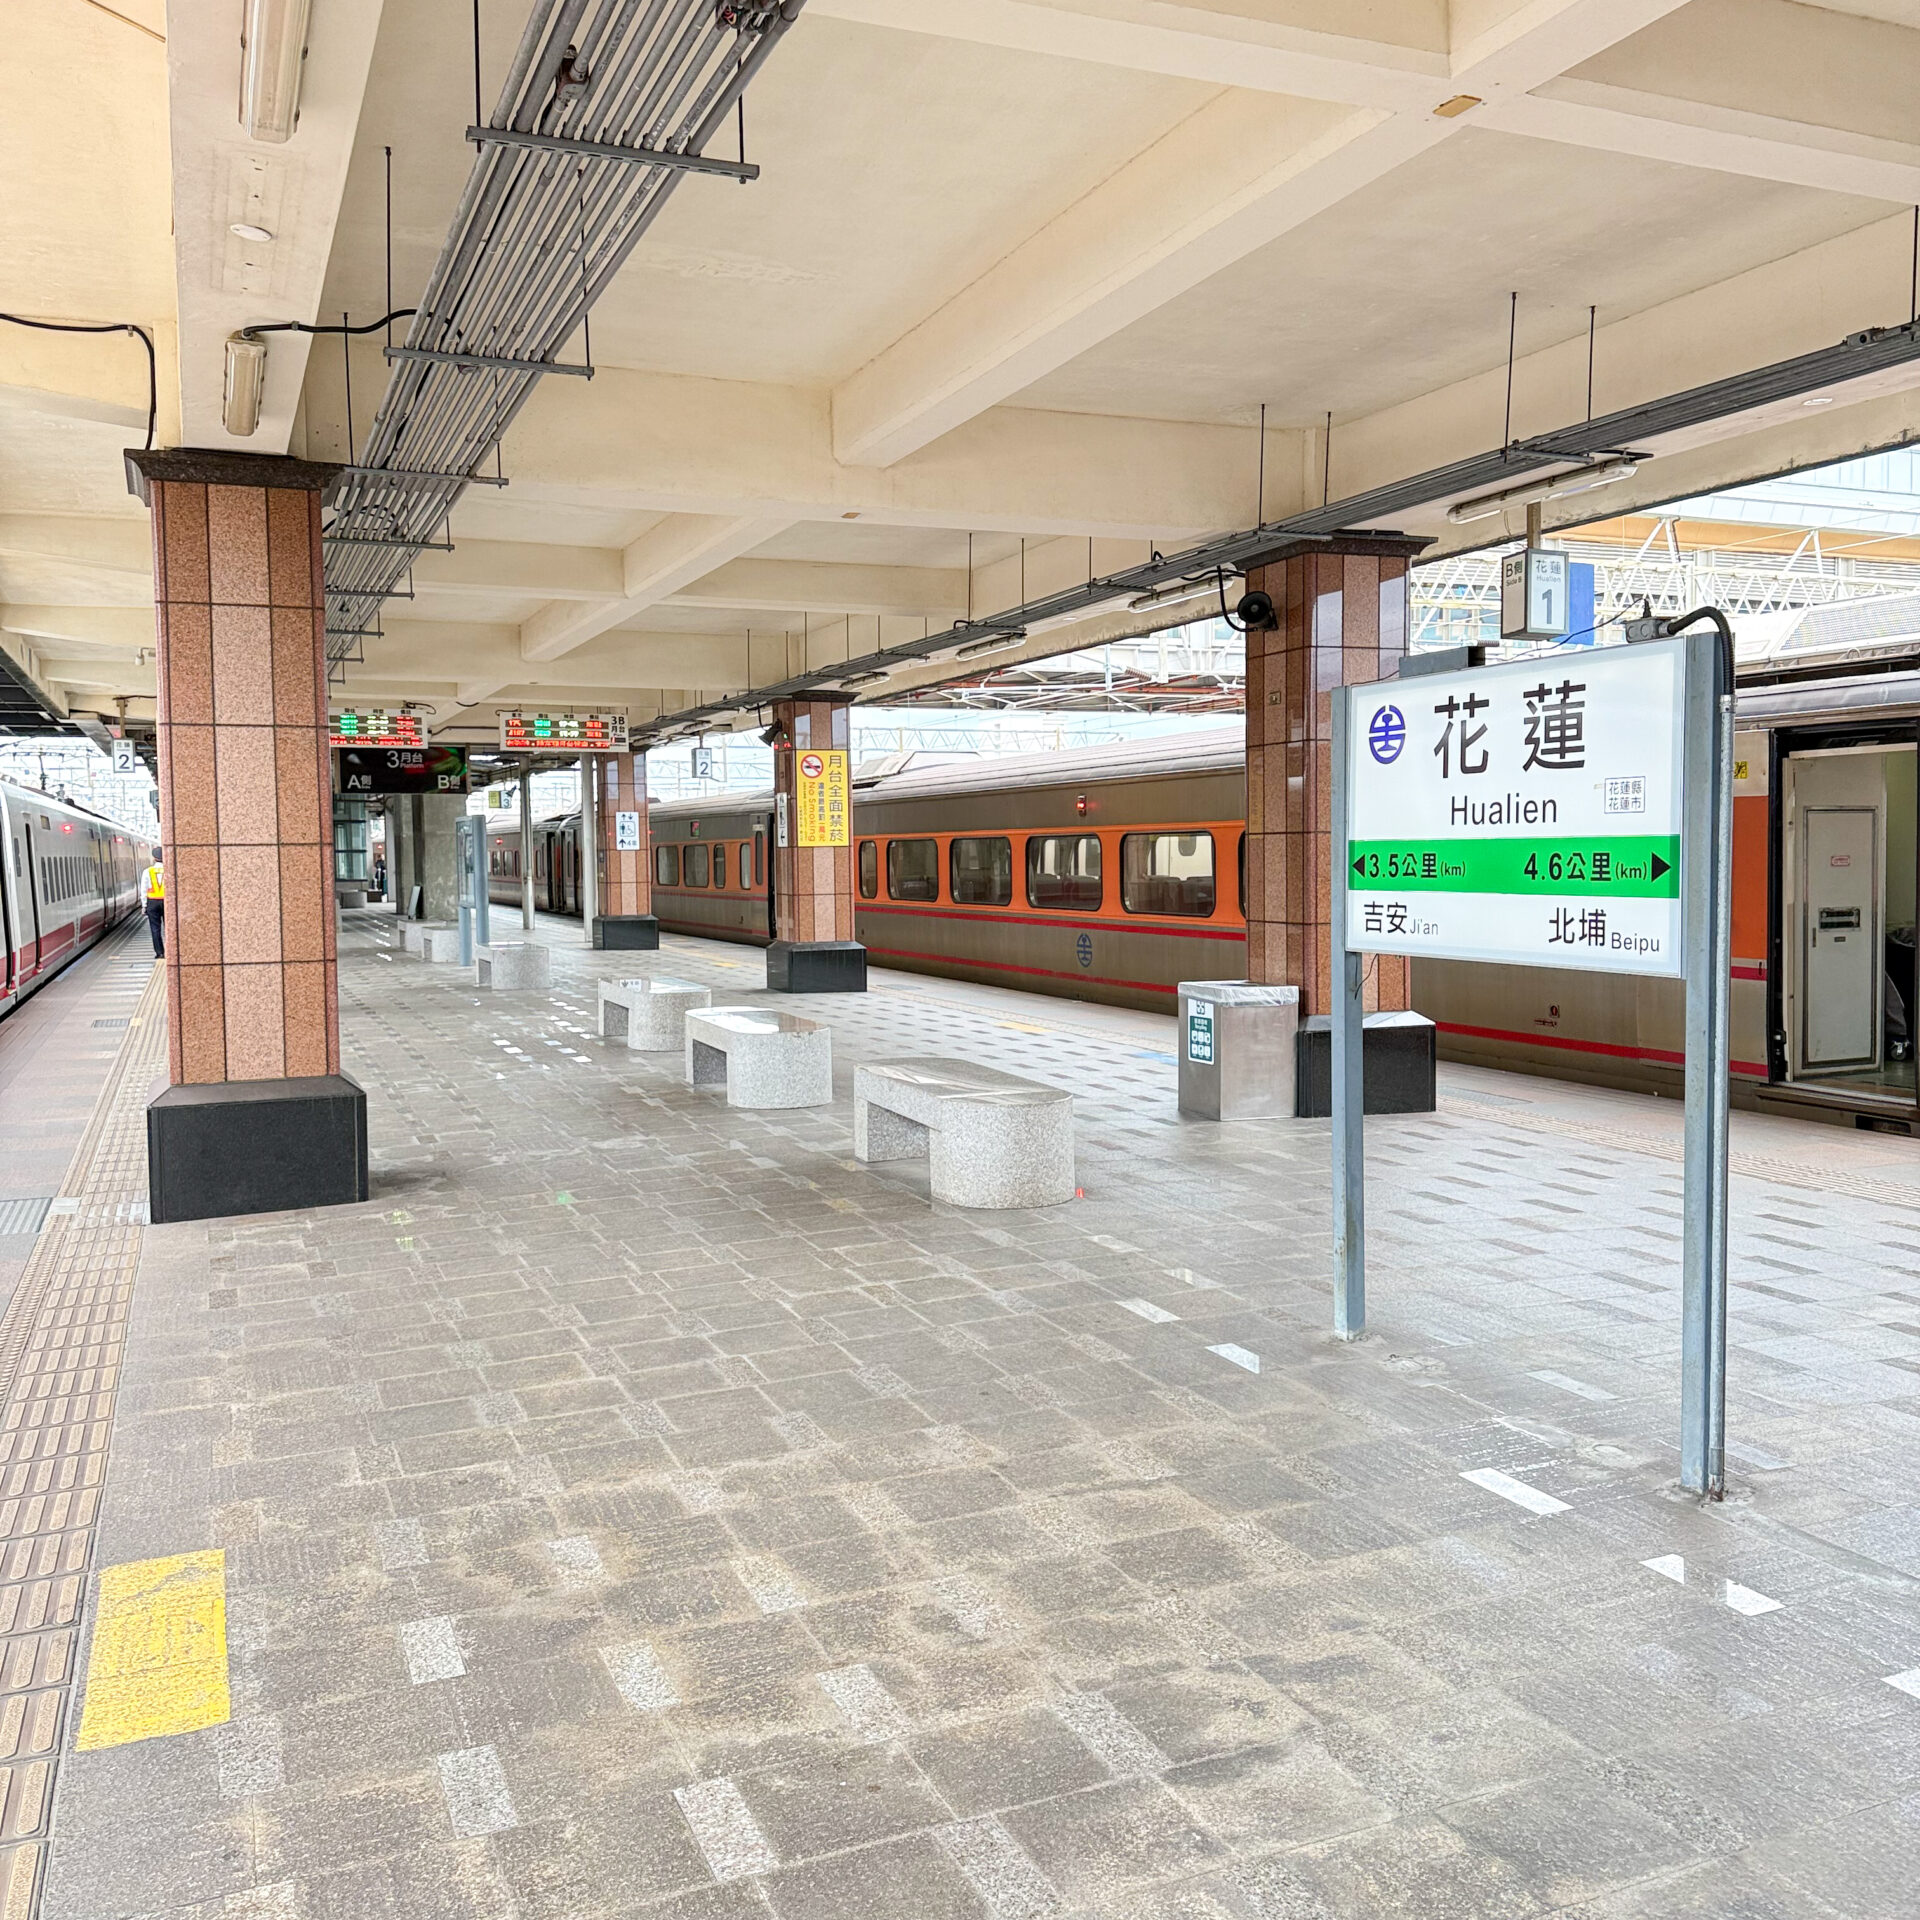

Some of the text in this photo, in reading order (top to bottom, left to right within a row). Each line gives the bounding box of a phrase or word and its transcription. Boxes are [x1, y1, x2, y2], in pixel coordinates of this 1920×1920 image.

[1506, 560, 1523, 577] B側
[1536, 560, 1561, 574] 花蓮
[1542, 589, 1552, 624] 1
[1433, 680, 1586, 779] 花蓮
[119, 754, 130, 769] 2
[700, 762, 709, 775] 2
[1609, 780, 1642, 795] 花蓮縣
[829, 755, 844, 842] 月台全面禁菸
[1609, 797, 1642, 811] 花蓮市
[1450, 793, 1557, 826] Hualien
[1363, 901, 1407, 934] 吉安
[1410, 918, 1439, 936] Ji'an
[1548, 906, 1607, 947] 北埔
[1611, 932, 1660, 955] Beipu
